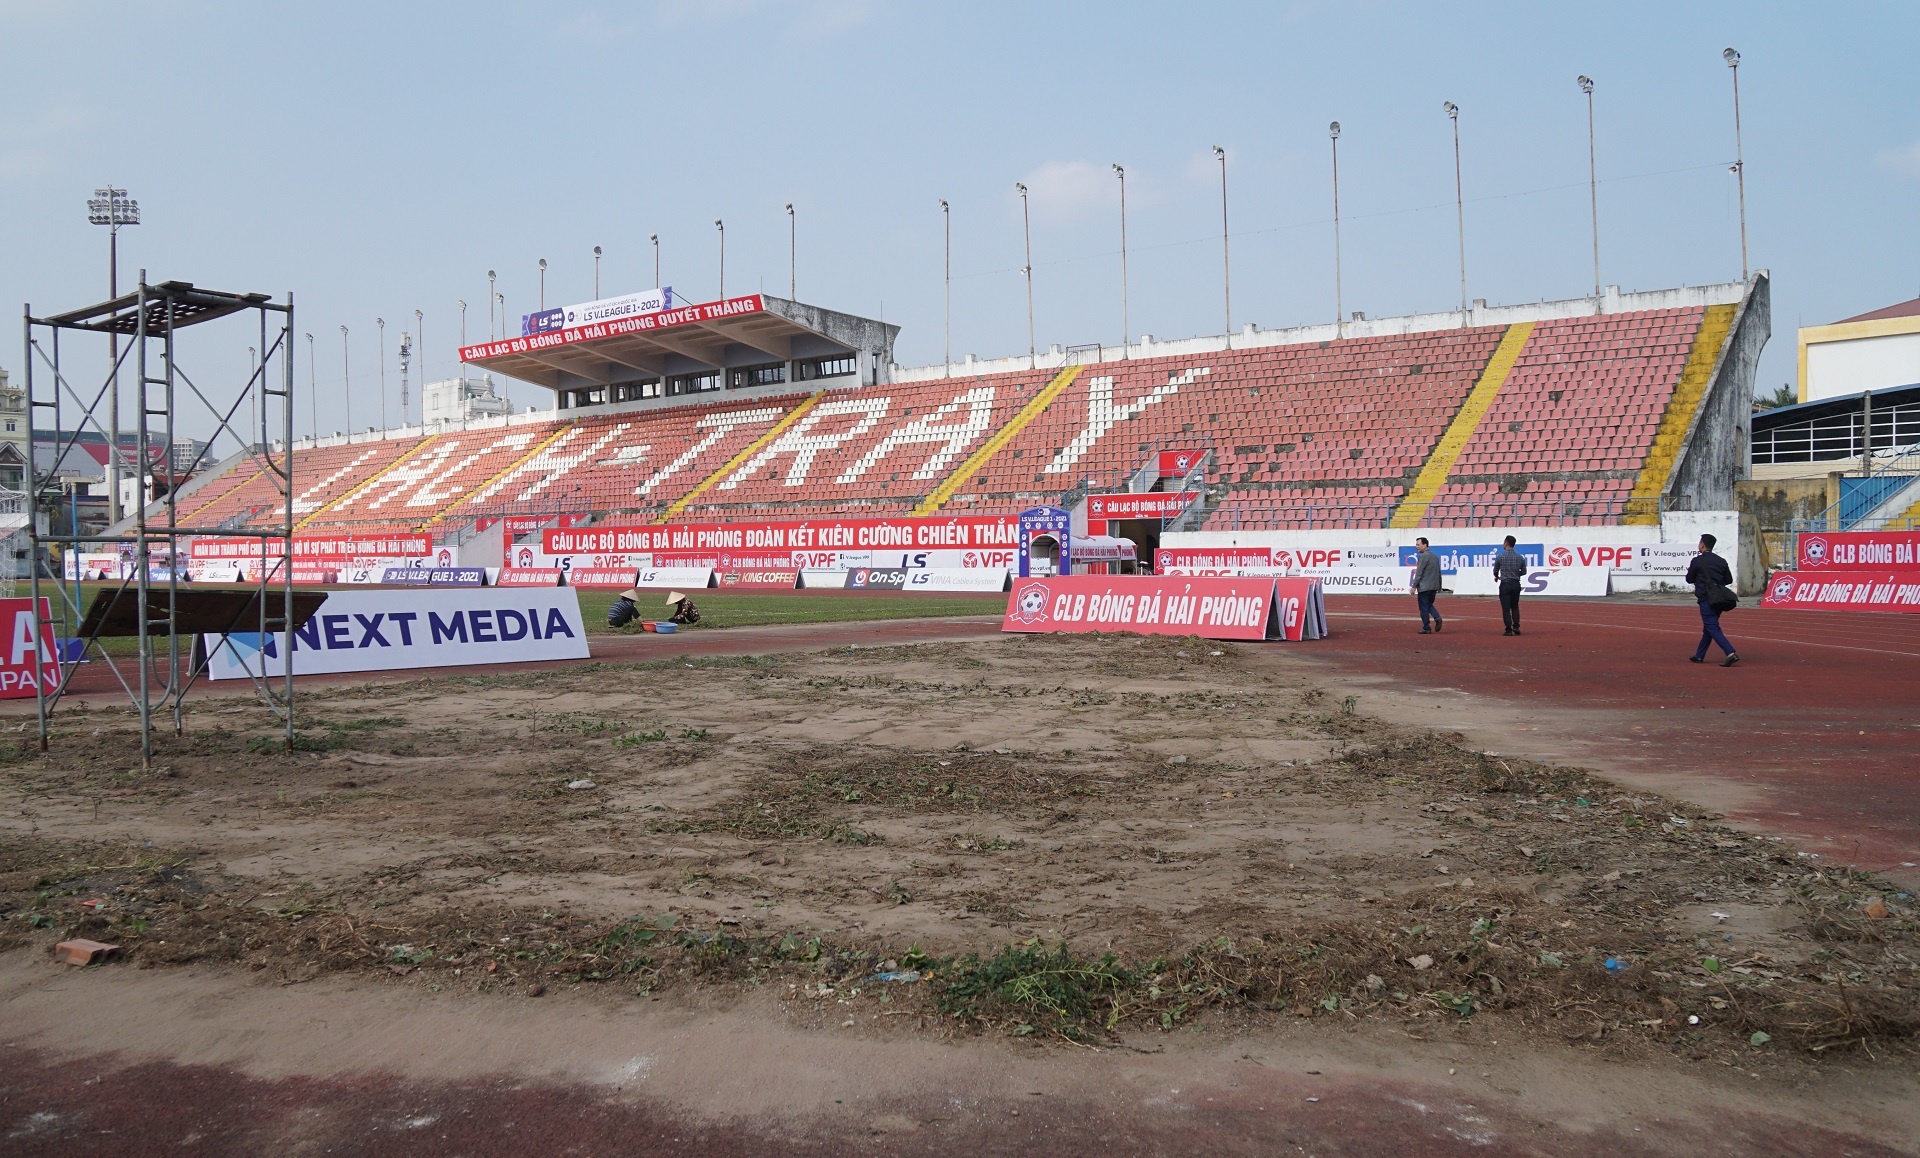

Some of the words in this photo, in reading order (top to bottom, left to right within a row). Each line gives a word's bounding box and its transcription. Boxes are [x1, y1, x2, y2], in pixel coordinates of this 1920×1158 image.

[584, 311, 592, 321] LS
[594, 305, 631, 319] V.LEAGUE
[641, 299, 660, 311] 2021
[538, 317, 549, 327] LS
[464, 348, 486, 360] CÂU
[488, 344, 510, 356] LẠC
[511, 338, 528, 352] BỘ
[529, 333, 562, 348] BÓNG
[564, 328, 582, 342] ĐÁ
[584, 323, 606, 339] HẢI
[609, 317, 655, 334] PHÒNG
[658, 307, 701, 327] QUYẾT
[1108, 501, 1118, 512] CÂU
[1120, 502, 1130, 514] LẠC
[1132, 500, 1140, 514] BỘ
[1140, 500, 1156, 512] BÓNG
[1158, 499, 1165, 511] ĐÁ
[552, 532, 574, 550] CÂU
[576, 534, 596, 553] LẠC
[600, 530, 614, 552] BỘ
[618, 530, 650, 549] BÓNG
[653, 528, 670, 548] ĐÁ
[672, 526, 694, 548] HẢI
[698, 526, 742, 548] PHÒNG
[746, 526, 784, 547] ĐOÀN
[788, 522, 814, 546] KẾT
[818, 524, 854, 546] KIÊN
[858, 522, 912, 546] CƯỜNG
[918, 518, 968, 545] CHIẾN
[974, 518, 1019, 544] THẮN
[194, 543, 208, 556] NHÂN
[209, 542, 220, 556] DÂN
[220, 542, 237, 556] THÀNH
[238, 540, 250, 556] PHỐ
[250, 543, 269, 556] CHUG
[270, 542, 280, 555] TAY
[294, 540, 302, 556] HỘ
[304, 540, 310, 554] VÌ
[311, 540, 320, 556] SỰ
[320, 539, 336, 554] PHÁT
[377, 538, 386, 553] ĐÁ
[388, 536, 400, 553] HẢI
[1834, 544, 1855, 564] CLB
[1858, 540, 1892, 564] BÓNG
[1896, 539, 1913, 563] ĐÁ
[362, 559, 376, 568] VPF
[604, 556, 625, 568] VPF
[733, 558, 741, 568] CLB
[743, 556, 755, 568] BÓNG
[756, 555, 763, 568] ĐÁ
[764, 554, 772, 568] HẢI
[773, 556, 790, 568] PHÒNG
[808, 553, 836, 567] VPF
[902, 554, 927, 568] LS
[980, 552, 1013, 568] VPF
[1176, 556, 1191, 567] CLB
[1192, 553, 1213, 567] BÓNG
[1214, 553, 1225, 567] ĐÁ
[1227, 550, 1241, 567] HẢI
[1242, 552, 1268, 567] PHÒNG
[1296, 550, 1341, 567] VPF
[1440, 550, 1469, 570] BẢO
[1473, 548, 1497, 567] HIỂ
[1523, 554, 1538, 567] TI
[1576, 547, 1632, 567] VPF
[353, 571, 369, 581] LS
[398, 571, 406, 580] LS
[408, 572, 429, 580] V.LEA
[432, 572, 449, 581] GUE
[458, 572, 479, 581] 2021
[643, 573, 656, 581] LS
[742, 573, 763, 582] KING
[763, 573, 795, 582] COFFEE
[869, 572, 886, 582] On
[888, 572, 905, 585] Sp
[912, 574, 930, 584] LS
[930, 576, 951, 584] VINA
[1320, 576, 1393, 586] BUNDESLIGA
[1520, 572, 1550, 592] S
[1795, 583, 1820, 602] CLB
[1817, 580, 1853, 602] BÓNG
[1850, 580, 1873, 603] ĐÁ
[1869, 576, 1896, 604] HẢI
[1053, 594, 1085, 621] CLB
[1086, 588, 1134, 624] BÓNG
[1136, 590, 1162, 624] ĐÁ
[1164, 583, 1196, 625] HẢI
[1198, 589, 1262, 627] PHÒNG
[291, 612, 416, 651] NEXT
[428, 607, 575, 645] MEDIA
[0, 611, 53, 665] A
[0, 668, 58, 690] PAN
